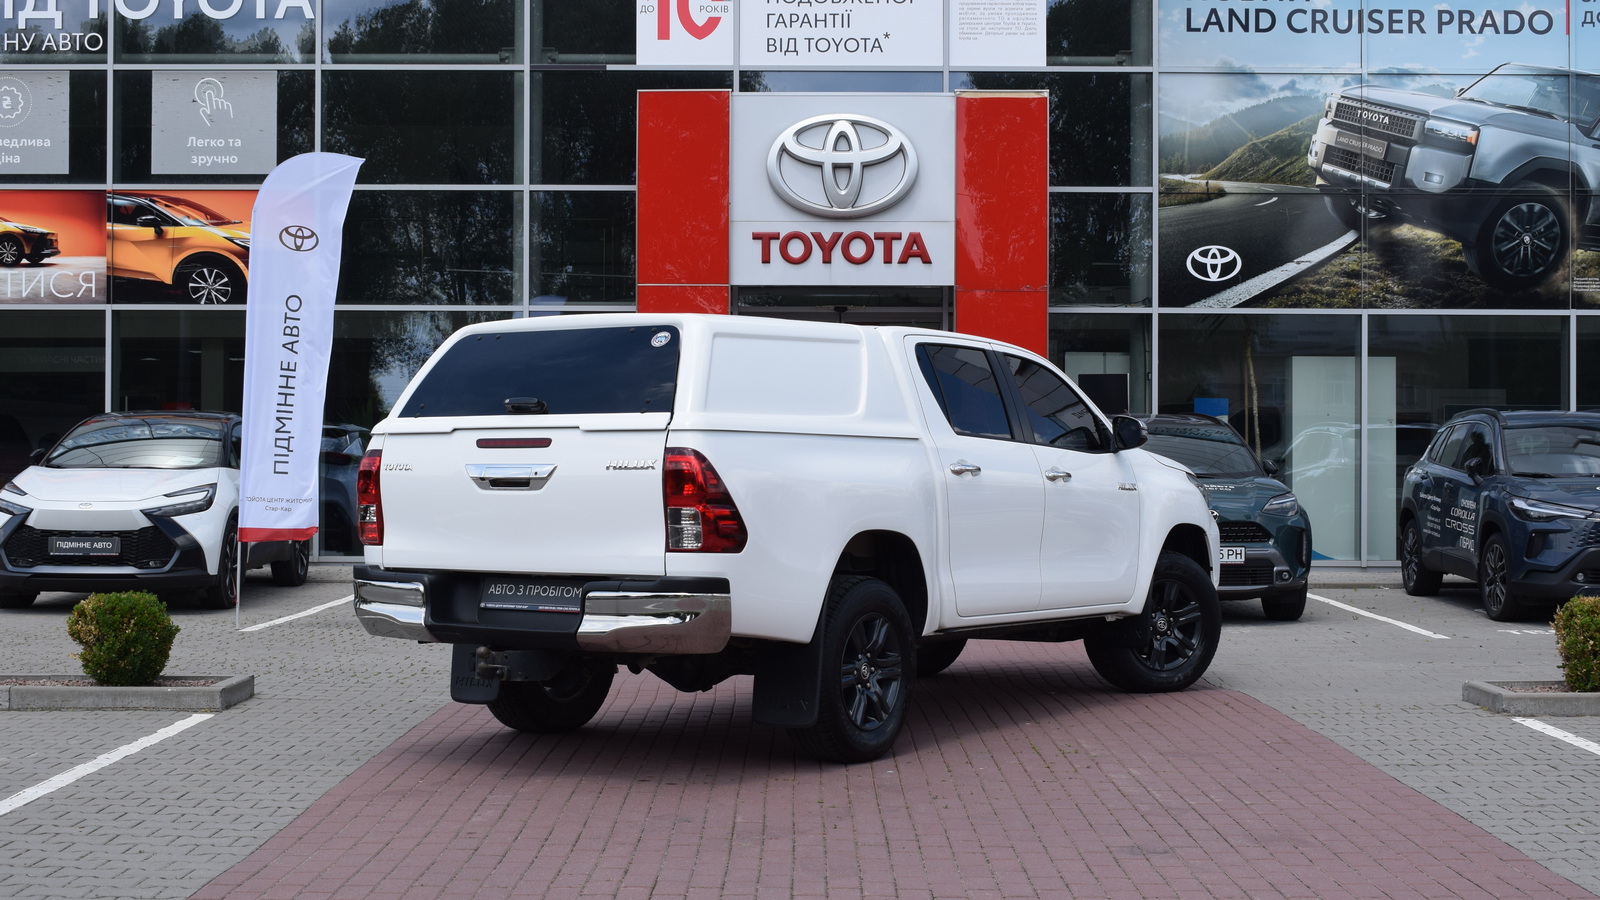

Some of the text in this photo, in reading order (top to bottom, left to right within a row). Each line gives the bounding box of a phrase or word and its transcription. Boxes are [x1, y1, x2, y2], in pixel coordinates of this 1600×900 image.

[640, 5, 655, 14] ДО
[699, 5, 729, 13] РОКІВ
[766, 9, 852, 28] ГАРАНТІЇ
[1186, 8, 1554, 35] LAND CRUISER PRADO
[4, 32, 103, 51] НУ АВТО
[766, 37, 799, 56] ВІД
[1357, 110, 1389, 124] TOYOTA
[187, 136, 241, 147] Легко та
[0, 152, 20, 165] іна
[191, 155, 238, 166] зручно
[752, 231, 932, 265] TOYOTA
[0, 270, 96, 298] ТИСЯ
[273, 294, 302, 475] ПІДМІННЕ АВТО
[384, 463, 413, 471] TOYOTA
[606, 459, 658, 470] HILUX
[1451, 507, 1475, 521] COROLLA
[1445, 518, 1475, 535] CROSS
[56, 541, 91, 549] ПІДМІННЕ
[1227, 549, 1242, 560] PH
[488, 584, 515, 595] АВТО
[526, 585, 583, 598] ПРОБІГОМ
